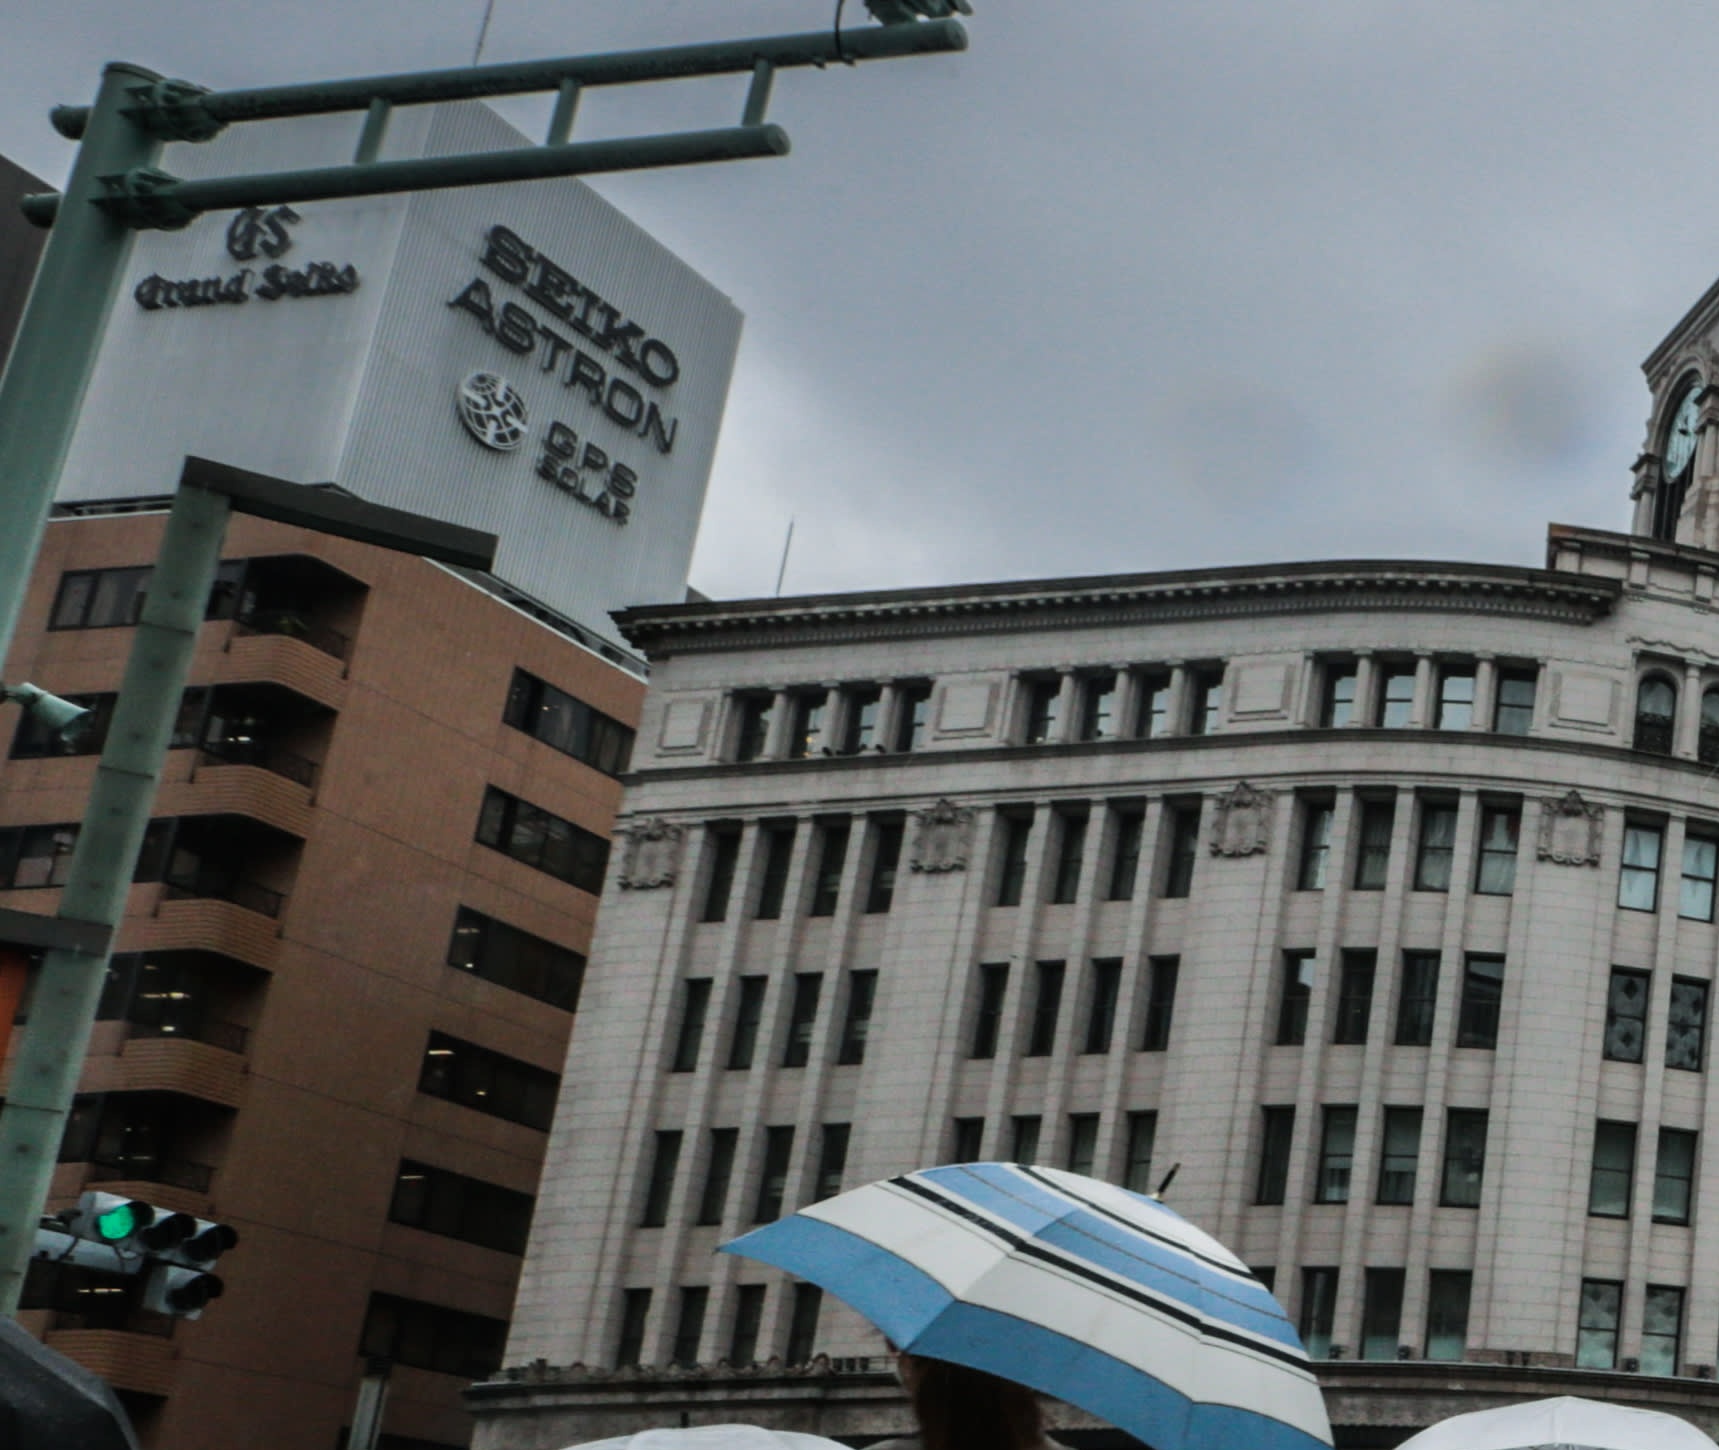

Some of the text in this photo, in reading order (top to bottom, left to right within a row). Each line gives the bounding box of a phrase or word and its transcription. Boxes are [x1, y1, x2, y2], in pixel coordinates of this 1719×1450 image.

[135, 261, 360, 312] Grand Seiko
[479, 223, 681, 390] SEIKO
[447, 278, 679, 456] ASTRON
[536, 457, 631, 527] SOLAR
[541, 420, 640, 502] GPS
